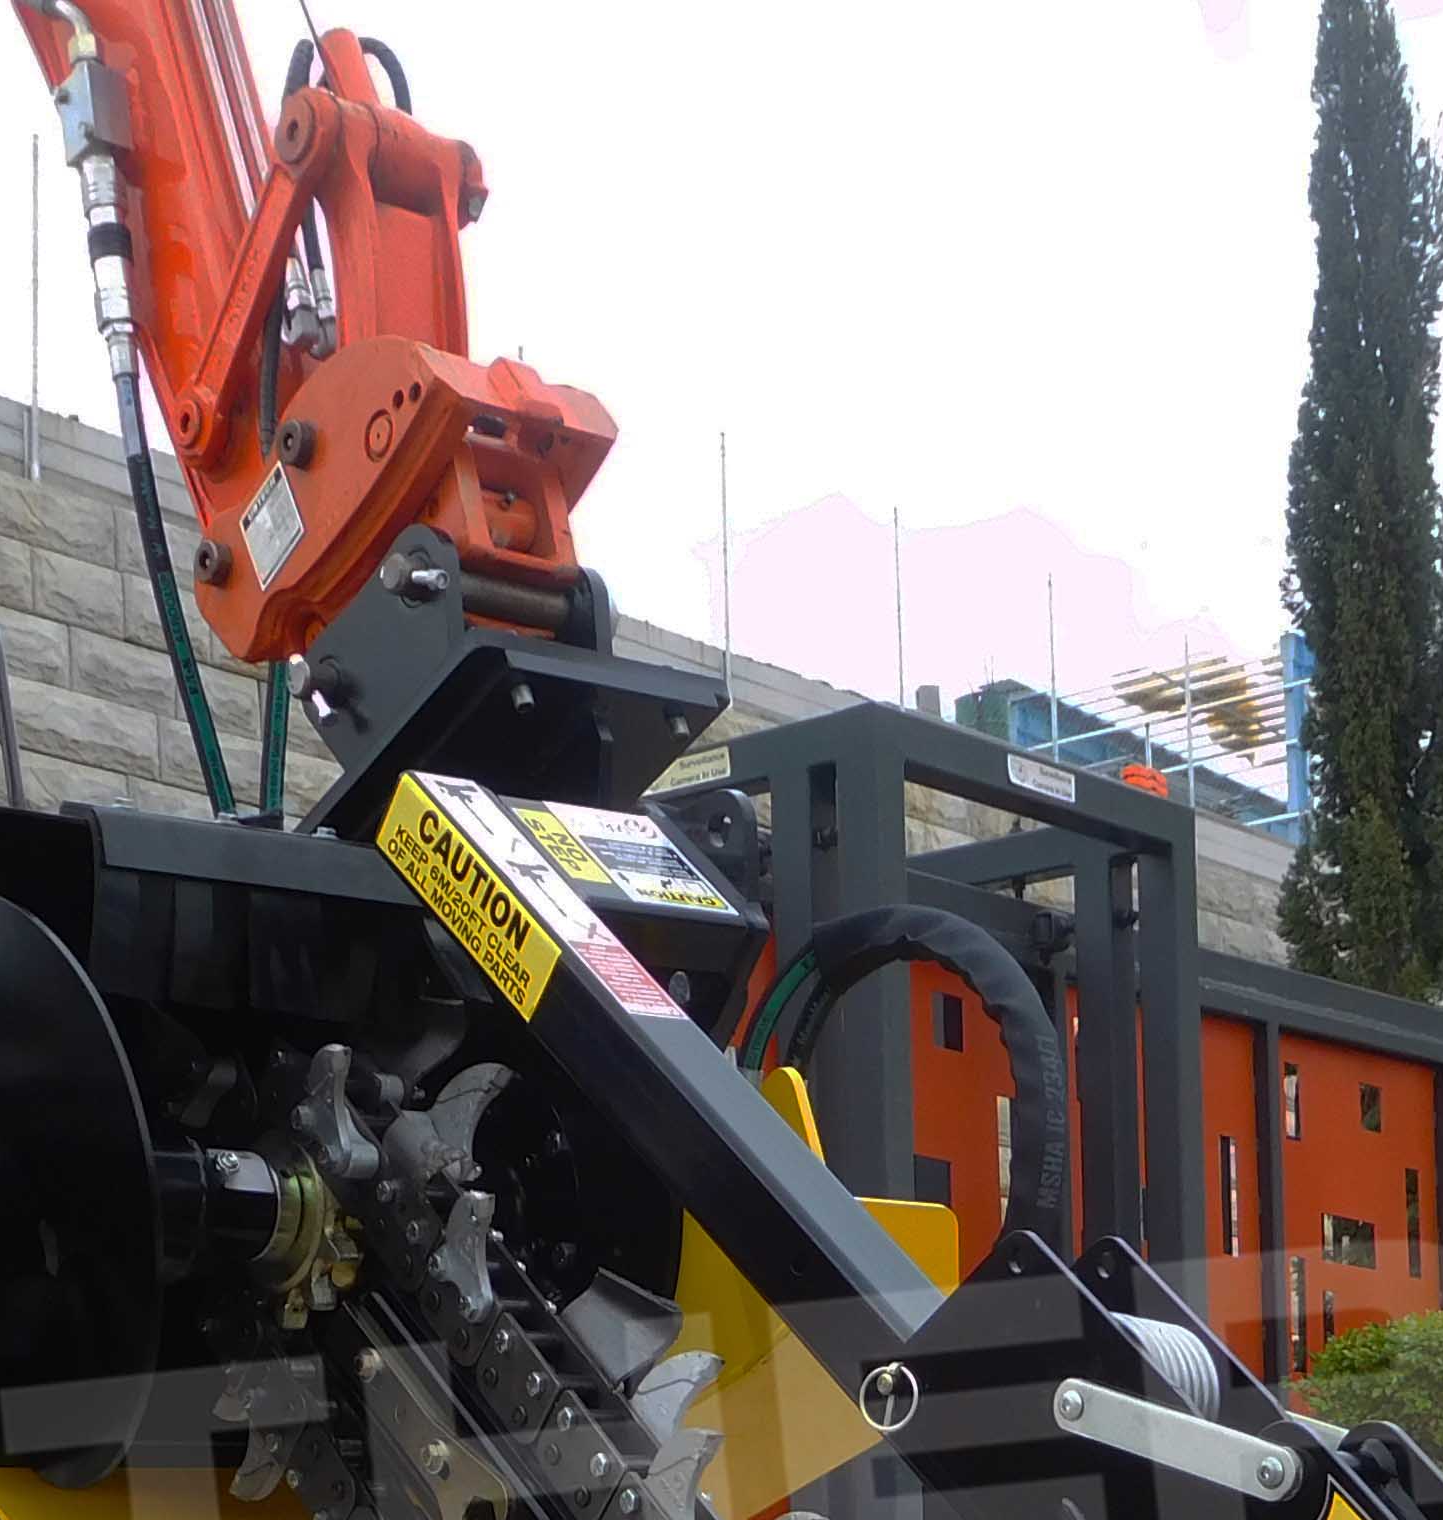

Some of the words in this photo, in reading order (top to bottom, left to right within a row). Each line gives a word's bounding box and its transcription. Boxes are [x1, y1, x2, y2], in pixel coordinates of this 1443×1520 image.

[395, 823, 429, 866] KEEP
[429, 865, 488, 936] 6M/20FT
[486, 931, 531, 990] CLEAR
[419, 809, 532, 954] CAUTION
[523, 816, 583, 873] STEP
[550, 831, 590, 864] NO
[387, 837, 407, 862] OF
[405, 859, 428, 892] ALL
[430, 889, 483, 956] MOVING
[482, 950, 527, 1007] PARTS
